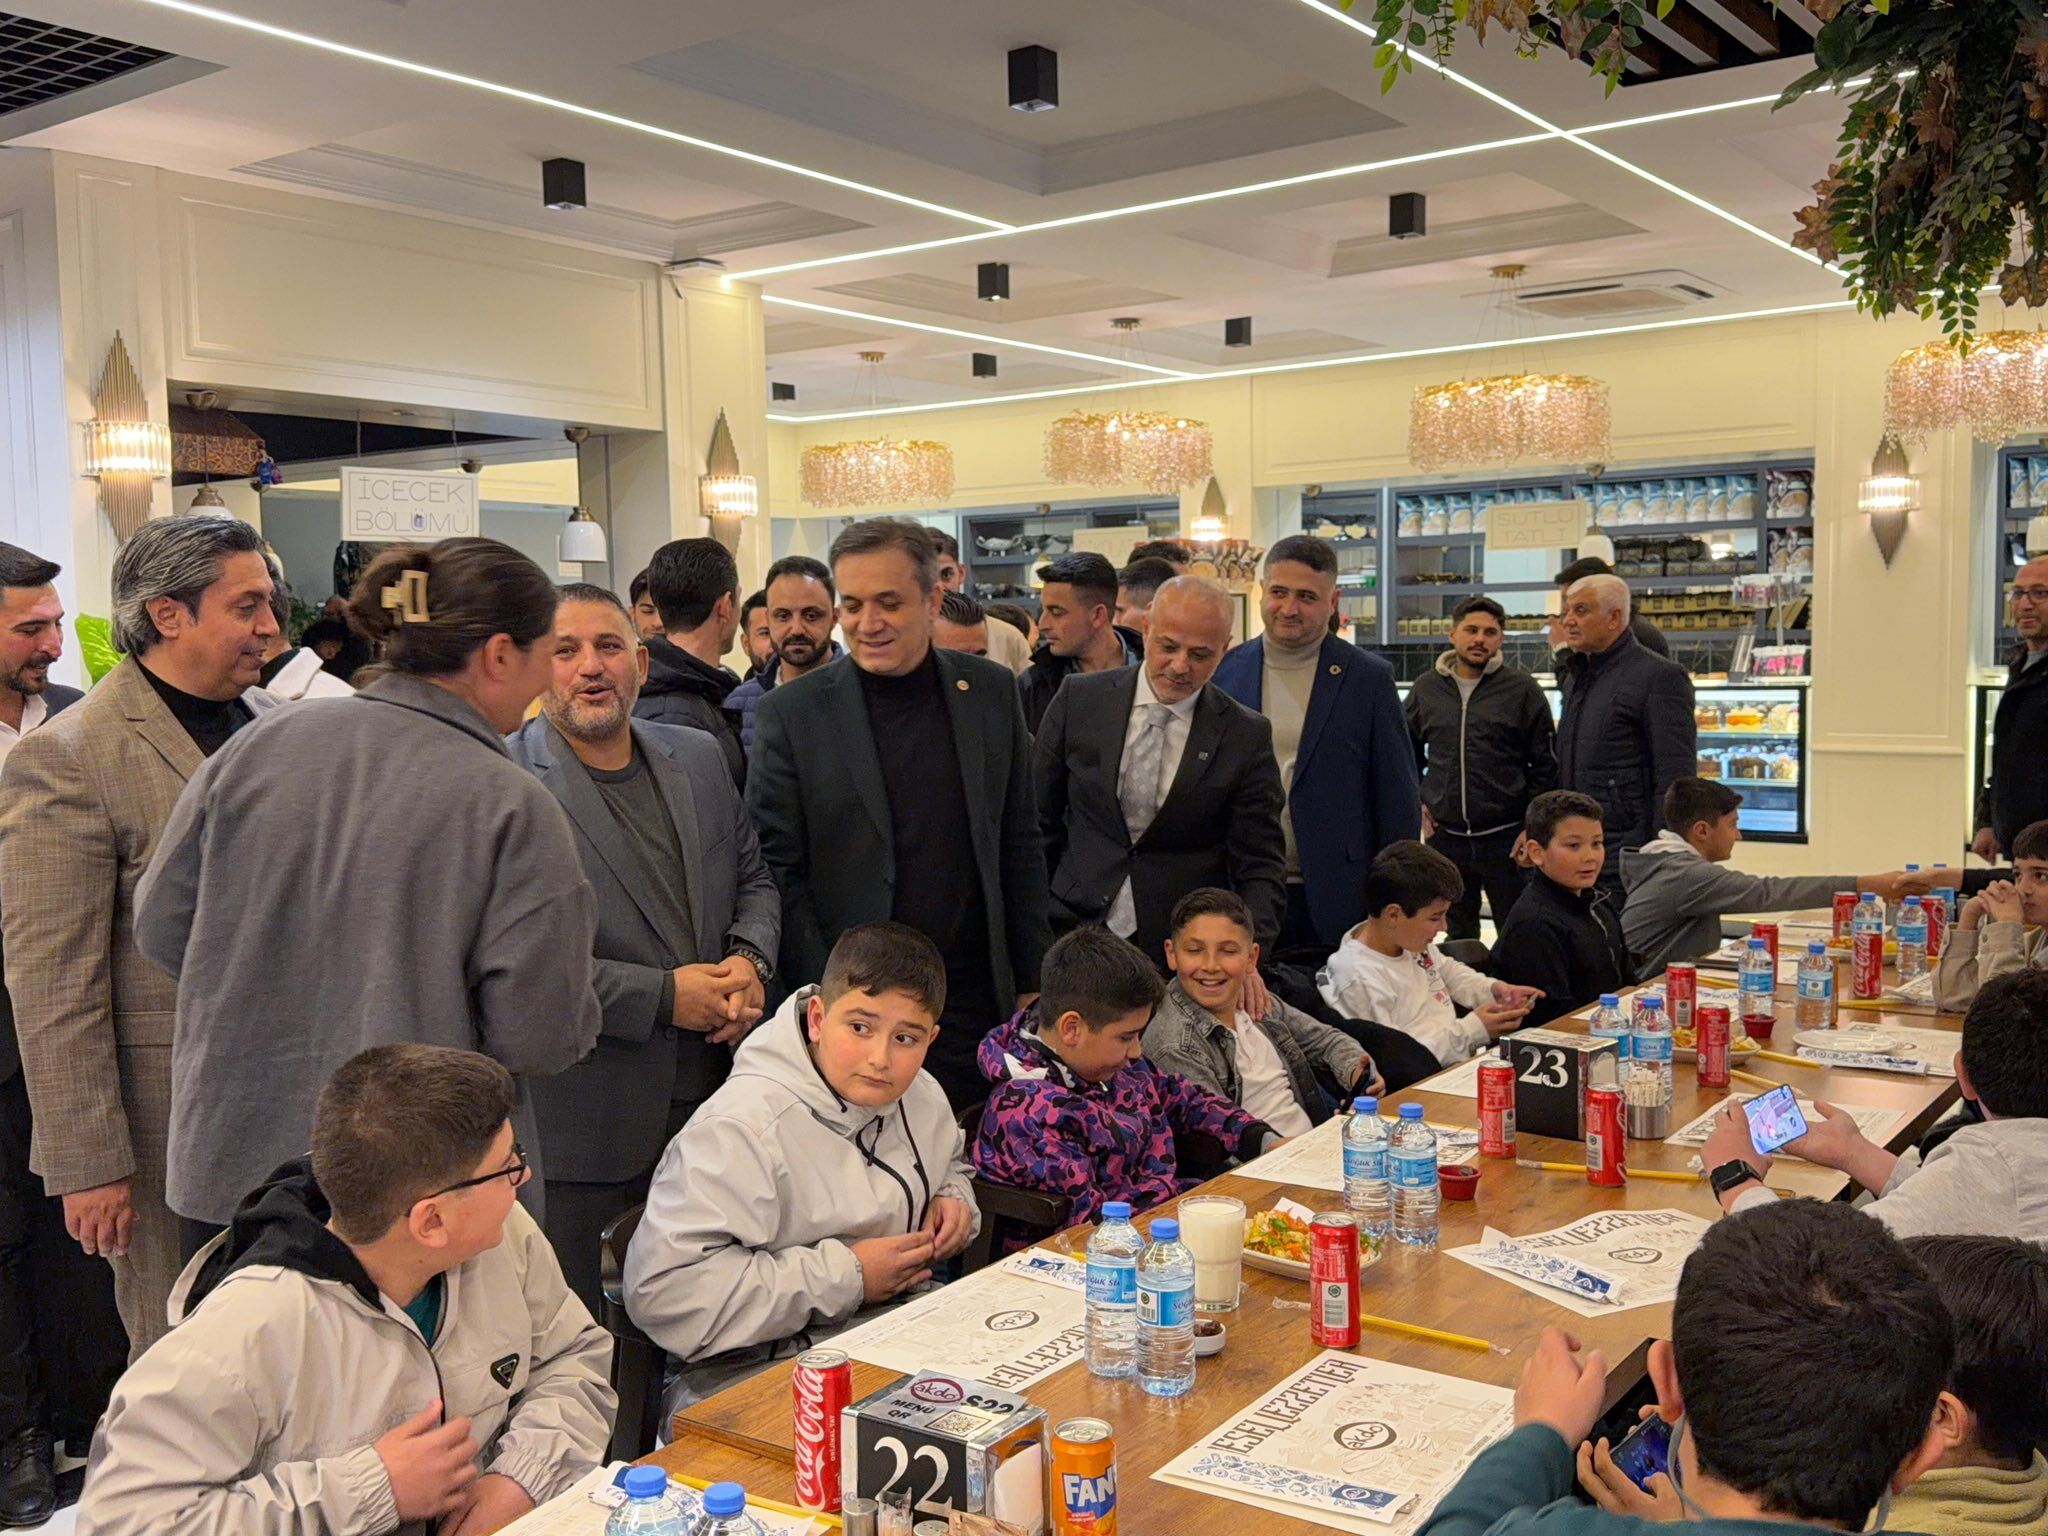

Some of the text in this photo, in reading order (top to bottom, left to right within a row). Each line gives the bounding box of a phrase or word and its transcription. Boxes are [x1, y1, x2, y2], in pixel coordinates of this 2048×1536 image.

[355, 506, 469, 534] BÖLÜMÜ
[1518, 1045, 1569, 1089] 23
[914, 1382, 959, 1400] akdo
[887, 1409, 912, 1420] QR
[890, 1399, 937, 1414] MENÜ
[960, 1394, 1014, 1415] S22
[873, 1435, 953, 1519] 22
